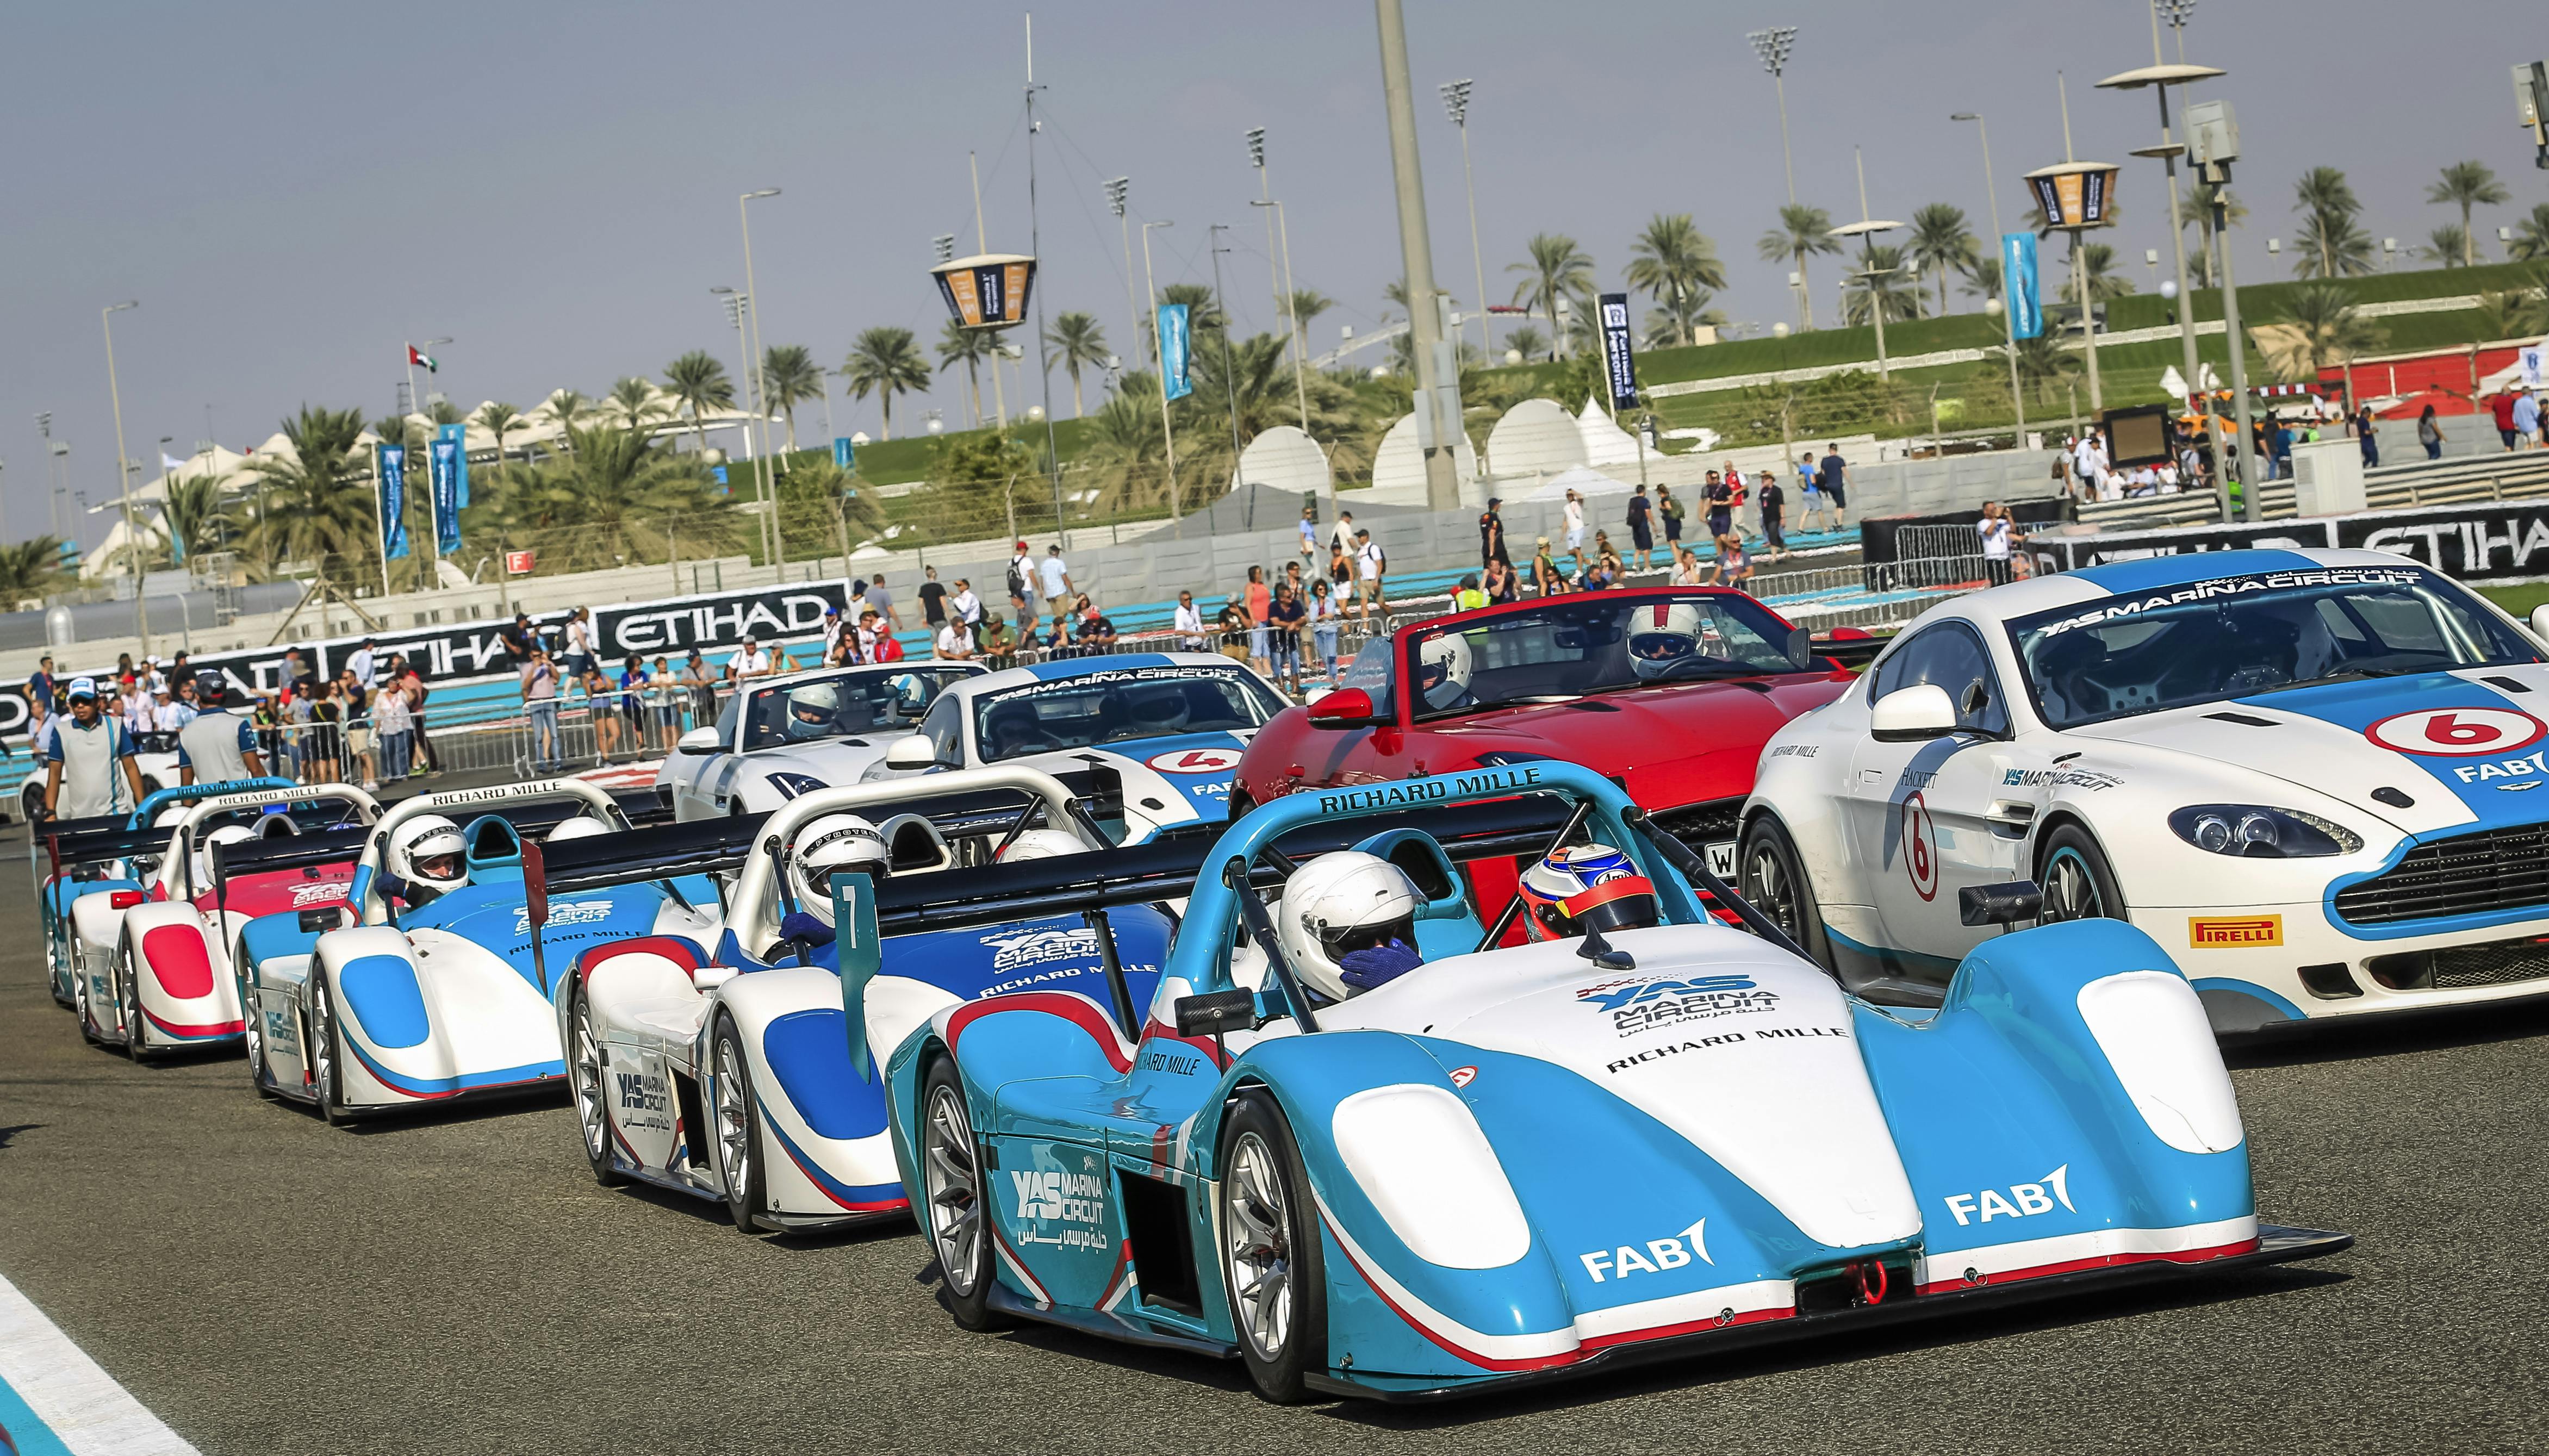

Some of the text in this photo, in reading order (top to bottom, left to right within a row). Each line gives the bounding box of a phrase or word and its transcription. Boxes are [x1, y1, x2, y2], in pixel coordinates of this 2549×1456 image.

[513, 555, 522, 569] F
[615, 594, 830, 650] ETIHAD
[2424, 713, 2502, 744] 6
[1178, 751, 1227, 767] 4
[177, 779, 268, 796] RICHARD MILLE
[1320, 767, 1542, 814] RICHARD MILLE
[1901, 767, 1938, 789] HACKETT
[219, 786, 322, 805] RICHARD MILLE
[433, 781, 562, 806] RICHARD MILLE
[1912, 811, 1929, 882] 6
[1711, 847, 1733, 874] W
[842, 885, 857, 949] 7
[984, 928, 1117, 951] YAS
[2196, 921, 2274, 942] PIRELLI
[979, 968, 1081, 998] RICHARD
[1575, 974, 1757, 1013] YAS
[1614, 991, 1780, 1021] MARINA
[1615, 998, 1781, 1030] CIRCUIT
[1606, 1028, 1850, 1074] RICHARD MILLE
[1165, 1055, 1201, 1076] MILLE
[616, 1073, 644, 1109] YAS
[642, 1075, 666, 1094] MARINA
[1010, 1171, 1062, 1219] YAS
[1061, 1173, 1103, 1199] MARINA
[1062, 1198, 1104, 1224] CIRCUIT
